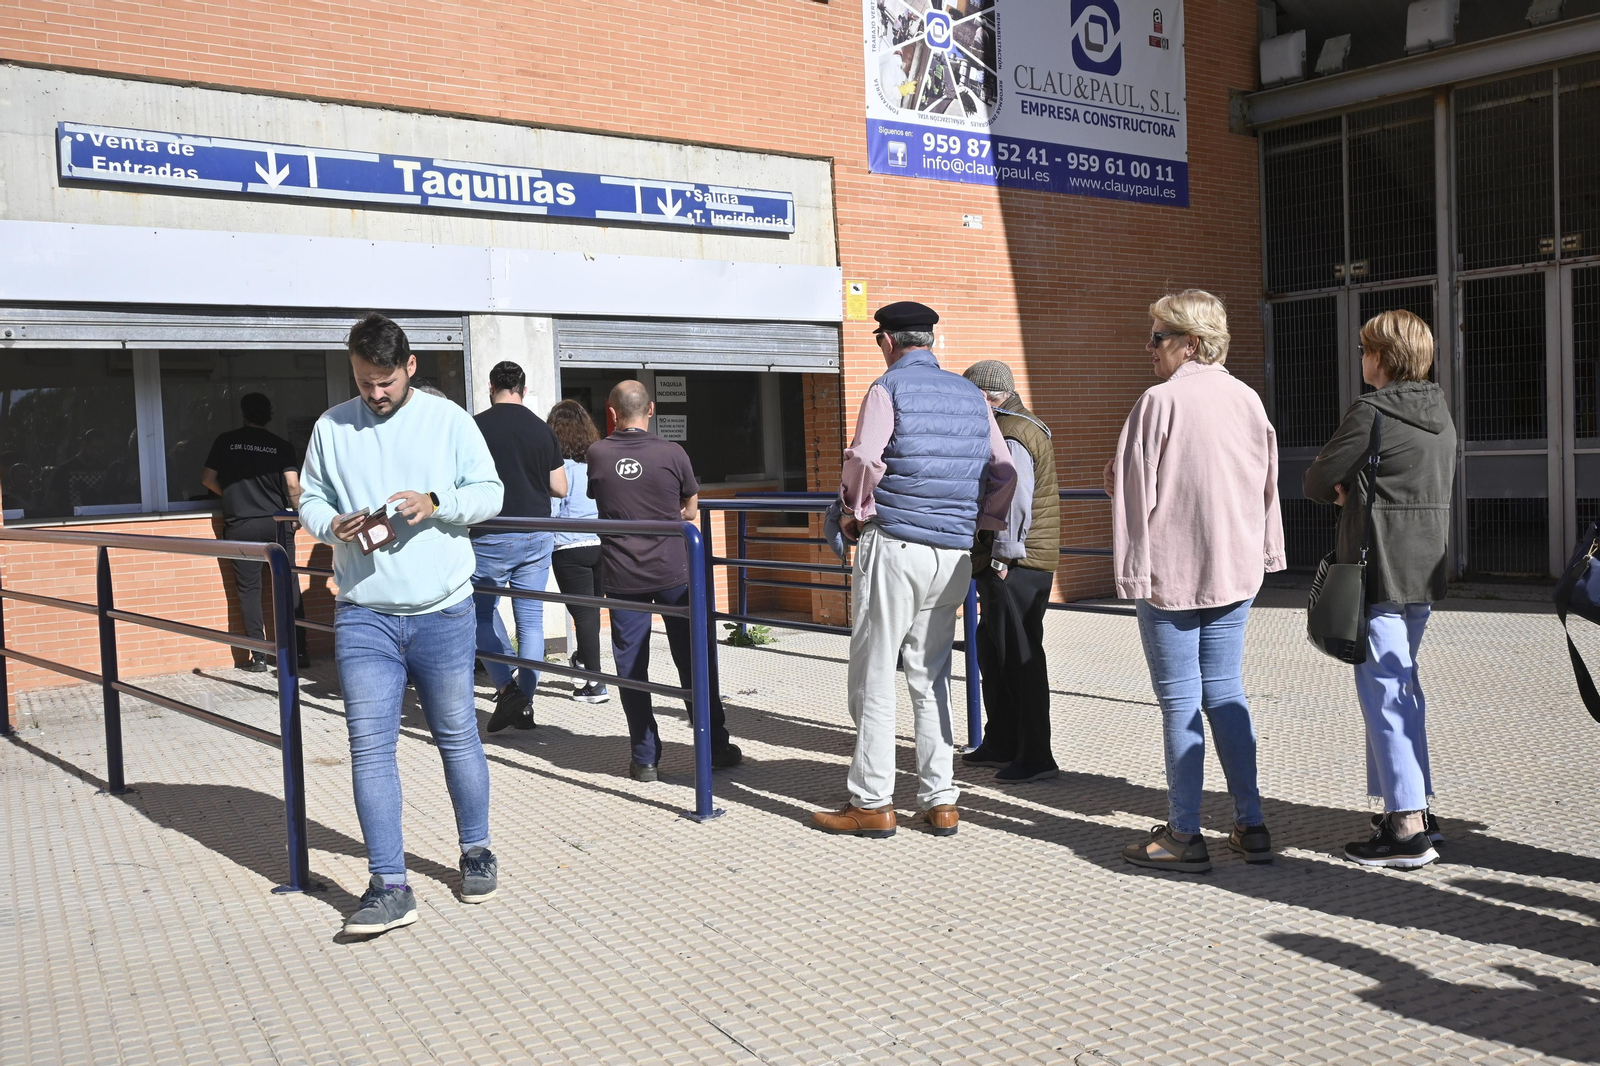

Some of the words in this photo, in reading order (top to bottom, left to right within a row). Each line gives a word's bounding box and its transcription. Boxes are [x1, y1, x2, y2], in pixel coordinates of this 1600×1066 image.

[1014, 64, 1145, 115] CLAU&PAUL,
[1150, 90, 1180, 116] S.L.
[1021, 99, 1080, 124] EMPRESA
[1083, 108, 1176, 138] CONSTRUCTORA
[89, 131, 159, 153] Venta
[168, 141, 195, 157] de
[878, 126, 904, 137] Síguenos
[92, 156, 199, 181] Entradas
[922, 132, 961, 156] 959
[967, 138, 992, 159] 87
[998, 143, 1022, 163] 52
[1026, 147, 1049, 166] 41
[1067, 152, 1100, 173] 959
[1105, 158, 1125, 176] 61
[1131, 161, 1151, 180] 00
[1155, 165, 1175, 182] 11
[922, 154, 1050, 183] info@clauypaul.es
[393, 159, 576, 206] Taquillas
[1069, 176, 1176, 199] www.clauypaul.es
[694, 189, 738, 205] Salida
[694, 210, 705, 223] T.
[711, 210, 793, 228] Incidencias
[254, 446, 278, 454] PALACIOS
